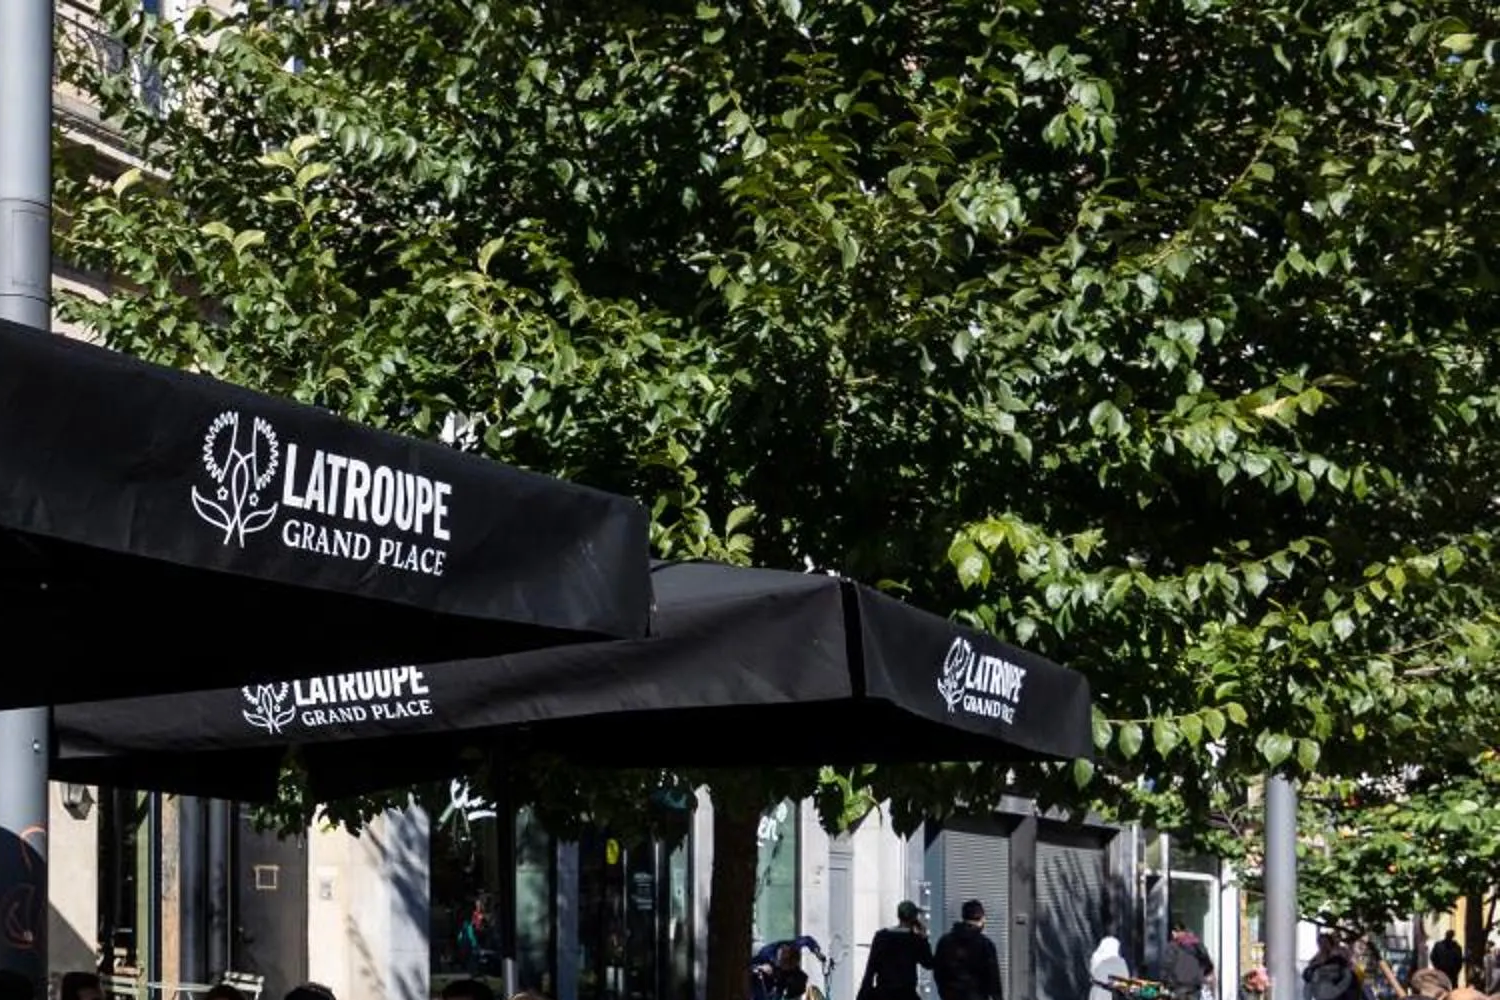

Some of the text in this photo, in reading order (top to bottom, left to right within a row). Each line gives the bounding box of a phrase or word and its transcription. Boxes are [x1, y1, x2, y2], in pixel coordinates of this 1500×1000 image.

[282, 443, 452, 541] LATROUPE
[282, 519, 447, 577] GRAND PLACE
[300, 699, 434, 727] GRAND PLACE
